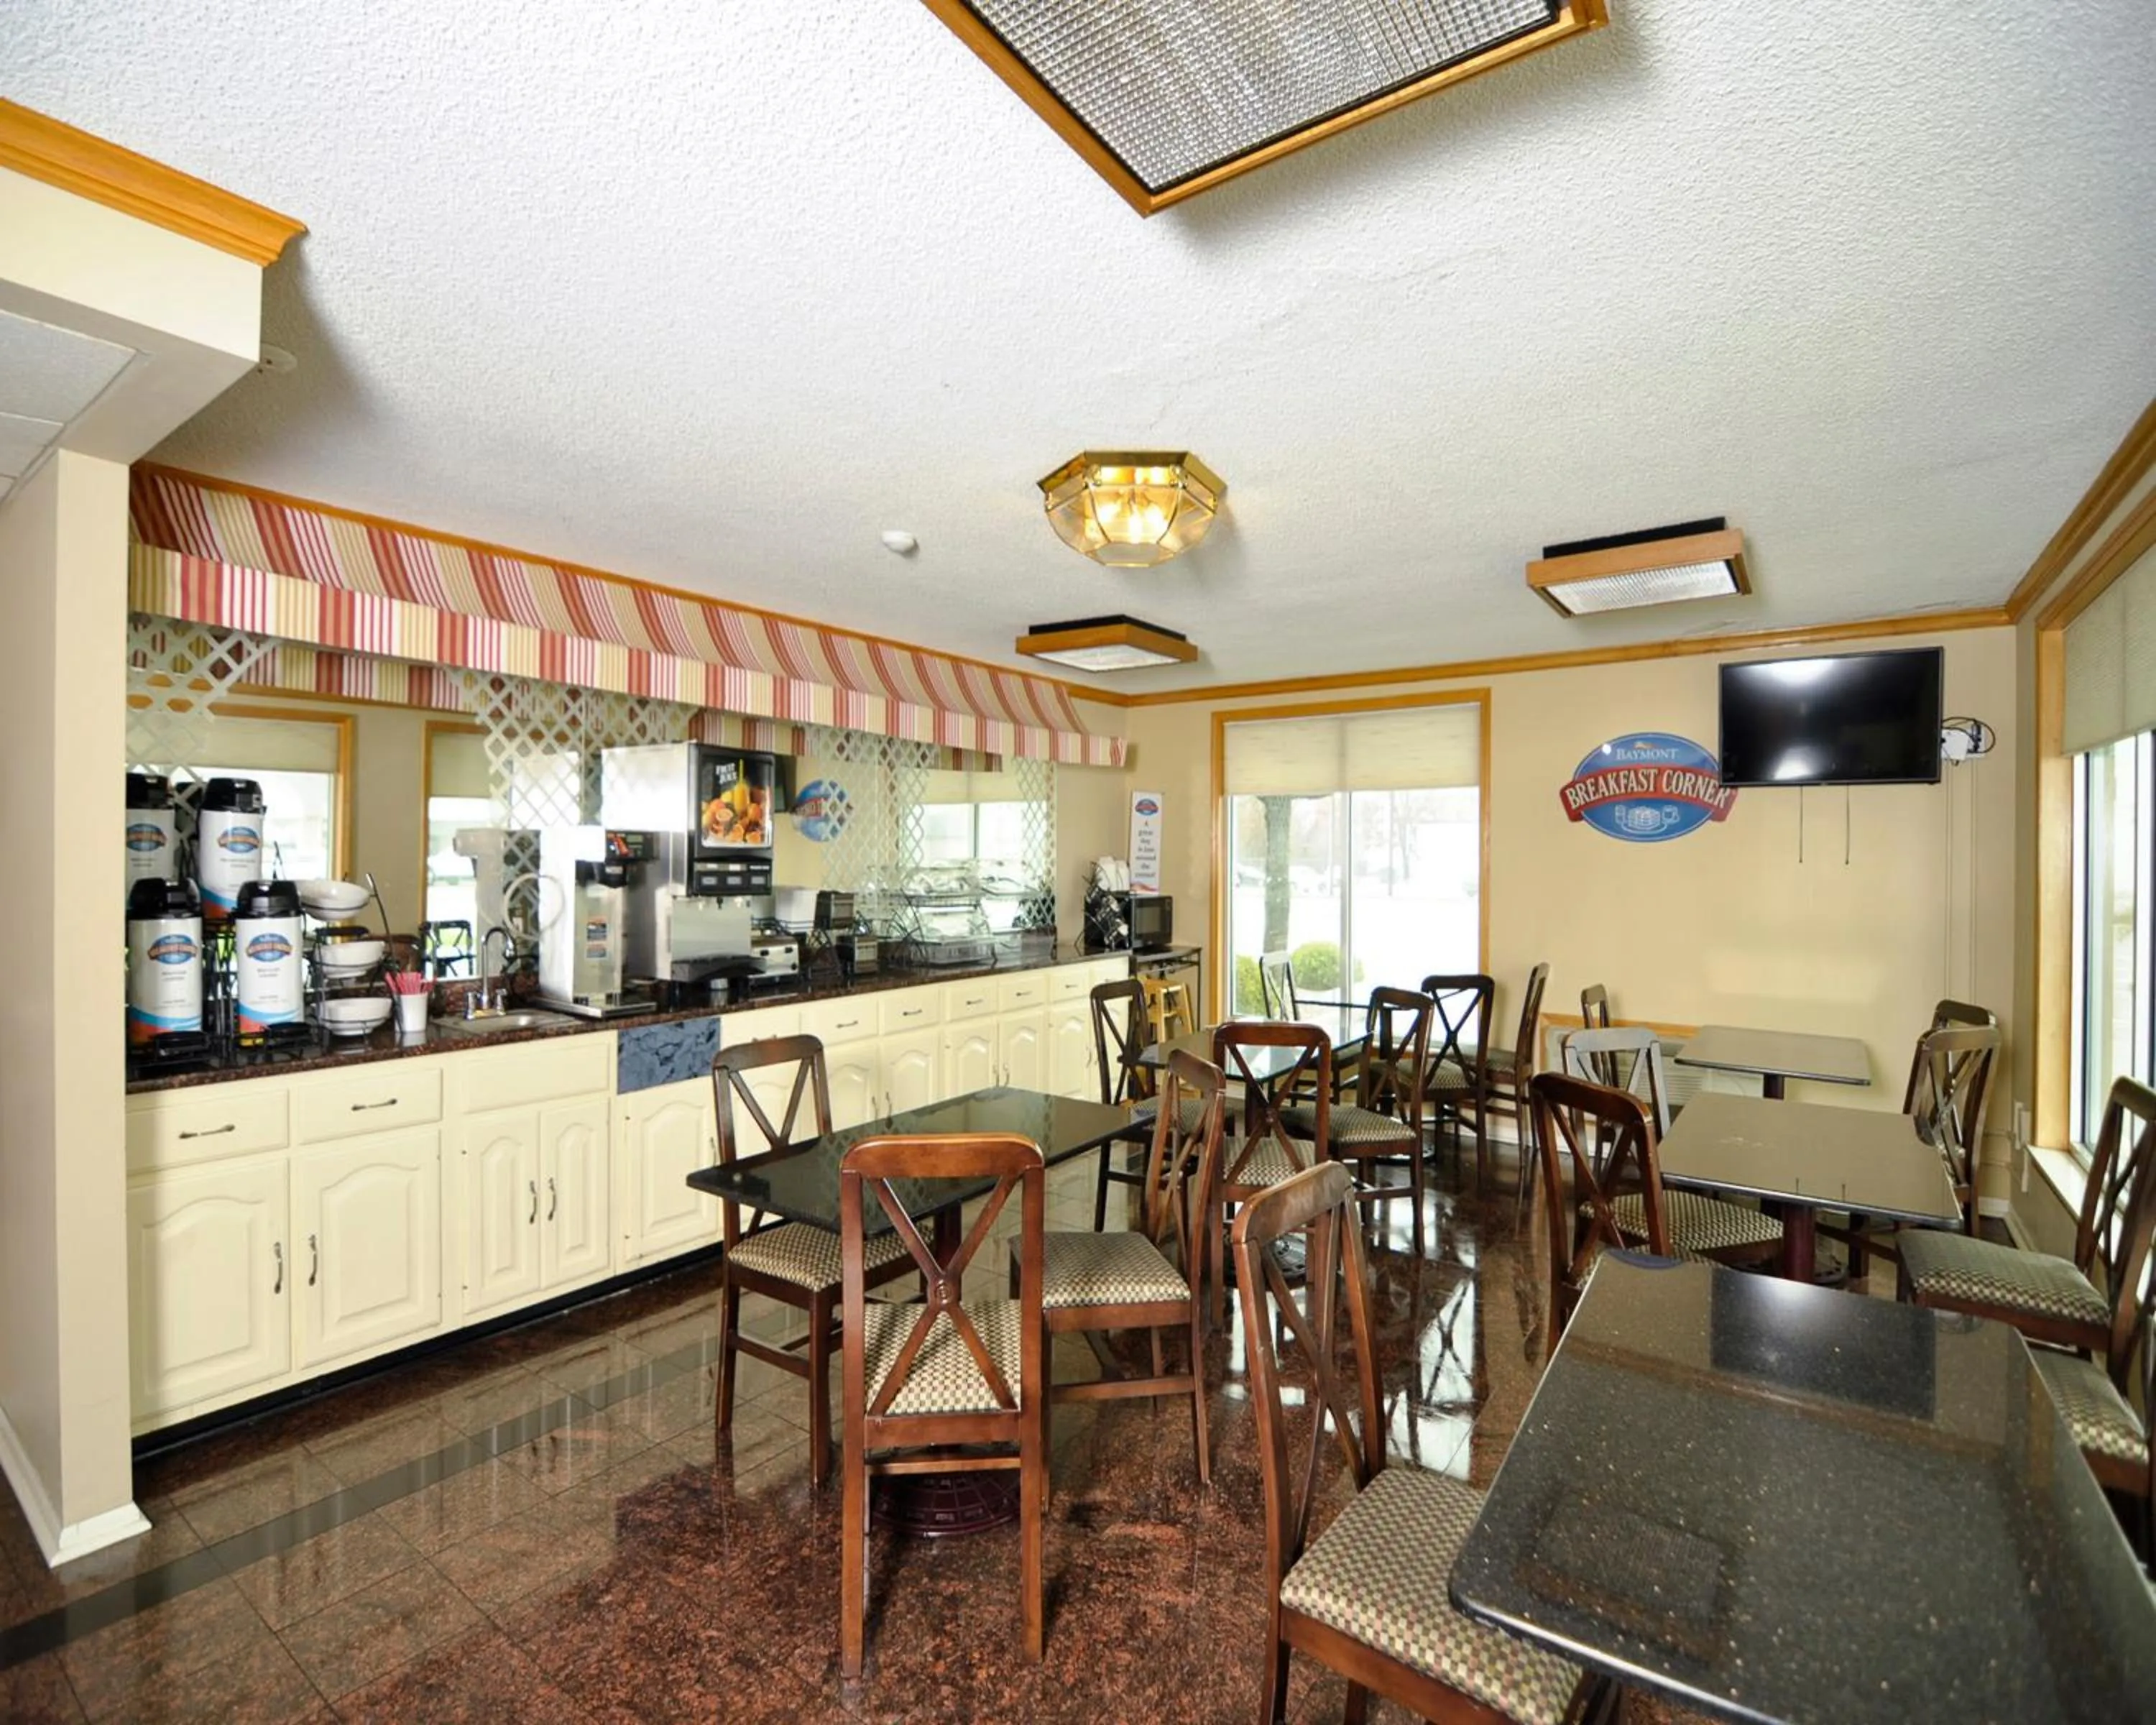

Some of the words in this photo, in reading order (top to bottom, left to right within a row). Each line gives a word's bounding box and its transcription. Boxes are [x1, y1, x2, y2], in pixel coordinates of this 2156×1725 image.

[1616, 748, 1680, 760] BAYMONT
[1565, 768, 1659, 810] BREAKFAST
[1662, 769, 1731, 809] CORNER
